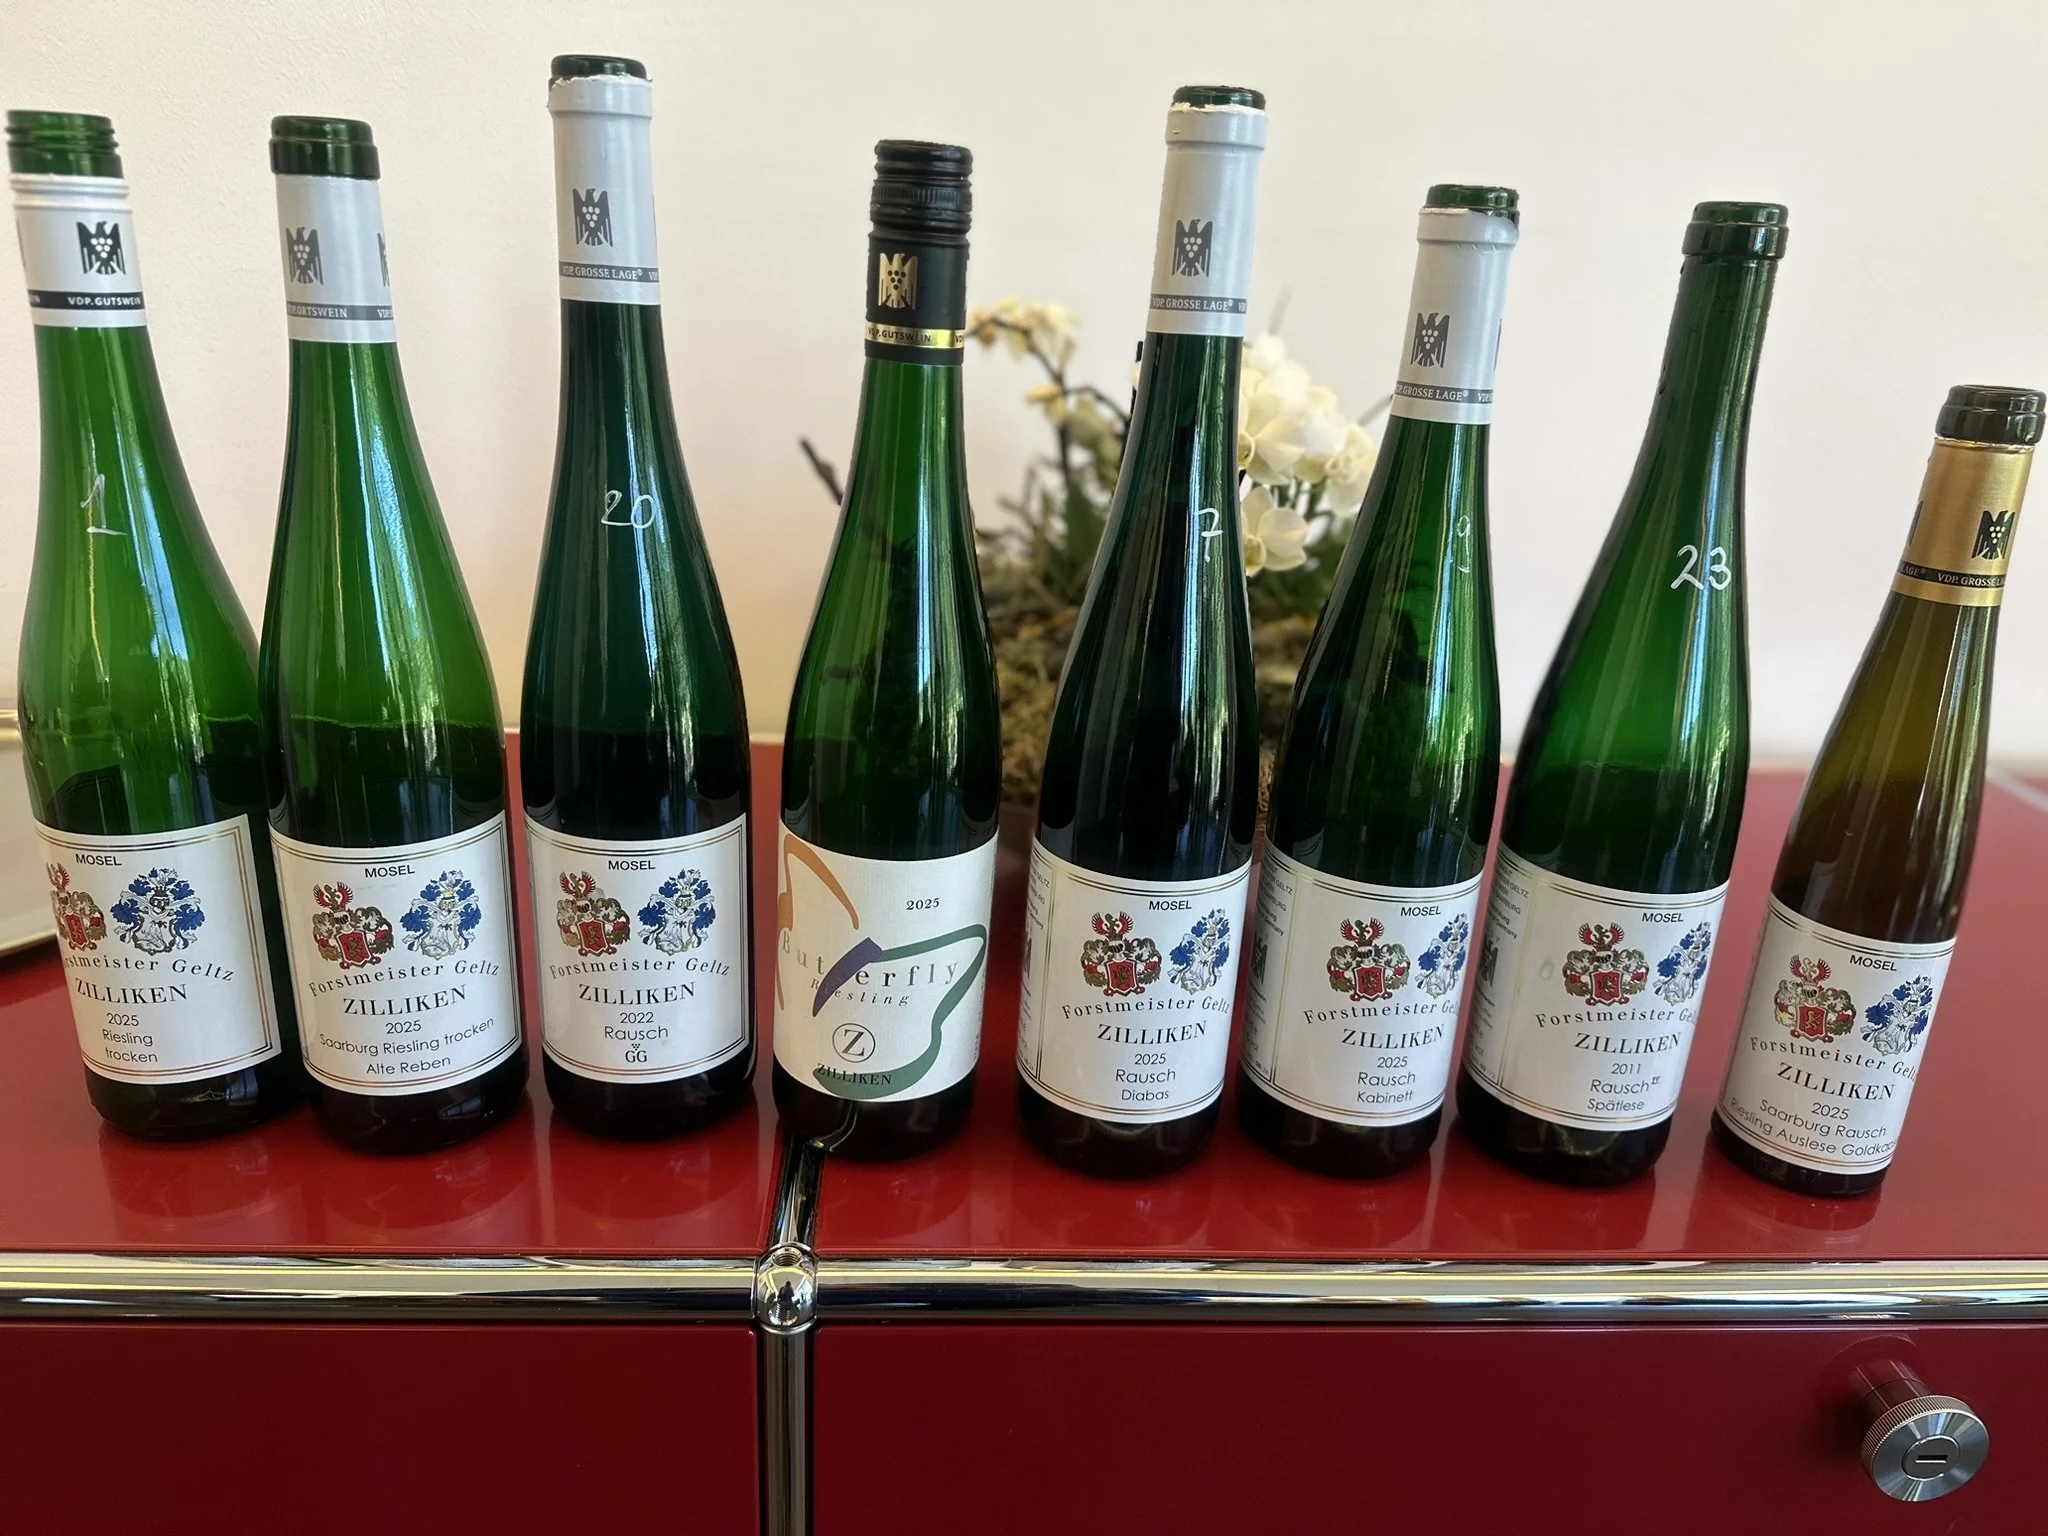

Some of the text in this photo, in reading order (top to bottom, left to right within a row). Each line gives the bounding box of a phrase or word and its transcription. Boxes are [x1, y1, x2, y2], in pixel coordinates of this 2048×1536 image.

[575, 267, 610, 278] GROSSE
[1166, 298, 1200, 309] GROSSE
[601, 490, 655, 529] 20
[1195, 507, 1223, 563] 7
[1670, 544, 1732, 590] 23
[75, 853, 122, 867] MOSEL
[608, 859, 656, 871] MOSEL
[364, 864, 415, 878] MOSEL
[906, 897, 940, 911] 2025
[1148, 899, 1192, 911] MOSEL
[1400, 905, 1442, 917] MOSEL
[1641, 912, 1684, 924] MOSEL
[172, 959, 235, 982] Geltz
[549, 957, 731, 980] Forstmeister Geltz
[1849, 954, 1898, 972] MOSEL
[308, 959, 501, 997] Forstmeister Geltz
[75, 977, 188, 1004] ZILLIKEN
[579, 981, 696, 1006] ZILLIKEN
[343, 984, 467, 1016] ZILLIKEN
[1062, 997, 1196, 1020] Forstmeister
[106, 1012, 140, 1027] 2025
[619, 1011, 655, 1024] 2022
[1304, 1003, 1438, 1025] Forstmeister
[1535, 1007, 1675, 1028] Forstmeister
[385, 1019, 422, 1035] 2025
[604, 1025, 669, 1041] Rausch
[1097, 1020, 1208, 1045] ZILLIKEN
[102, 1029, 153, 1046] Riesling
[320, 1016, 495, 1057] Saarburg Riesling trocken
[1341, 1023, 1445, 1049] ZILLIKEN
[1574, 1031, 1682, 1055] ZILLIKEN
[105, 1048, 158, 1063] trocken
[625, 1050, 648, 1063] GG
[1134, 1053, 1167, 1066] 2025
[1749, 1036, 1887, 1071] Forstmeister
[366, 1055, 451, 1075] Alte Reben
[1377, 1056, 1408, 1069] 2025
[1611, 1063, 1641, 1075] 2011
[816, 1062, 893, 1086] ZILLIKEN
[1115, 1068, 1176, 1084] Rausch
[1357, 1071, 1416, 1087] Rausch
[1777, 1061, 1896, 1101] ZILLIKEN
[1590, 1079, 1650, 1094] Rausch
[1121, 1089, 1170, 1102] Diabas
[1357, 1090, 1414, 1104] Kabinett
[1587, 1098, 1645, 1112] Spätlese
[1811, 1102, 1850, 1121] 2025
[1730, 1097, 1773, 1136] Riesling
[1776, 1128, 1837, 1154] Auslese
[1759, 1099, 1887, 1139] Saarburg Rausch
